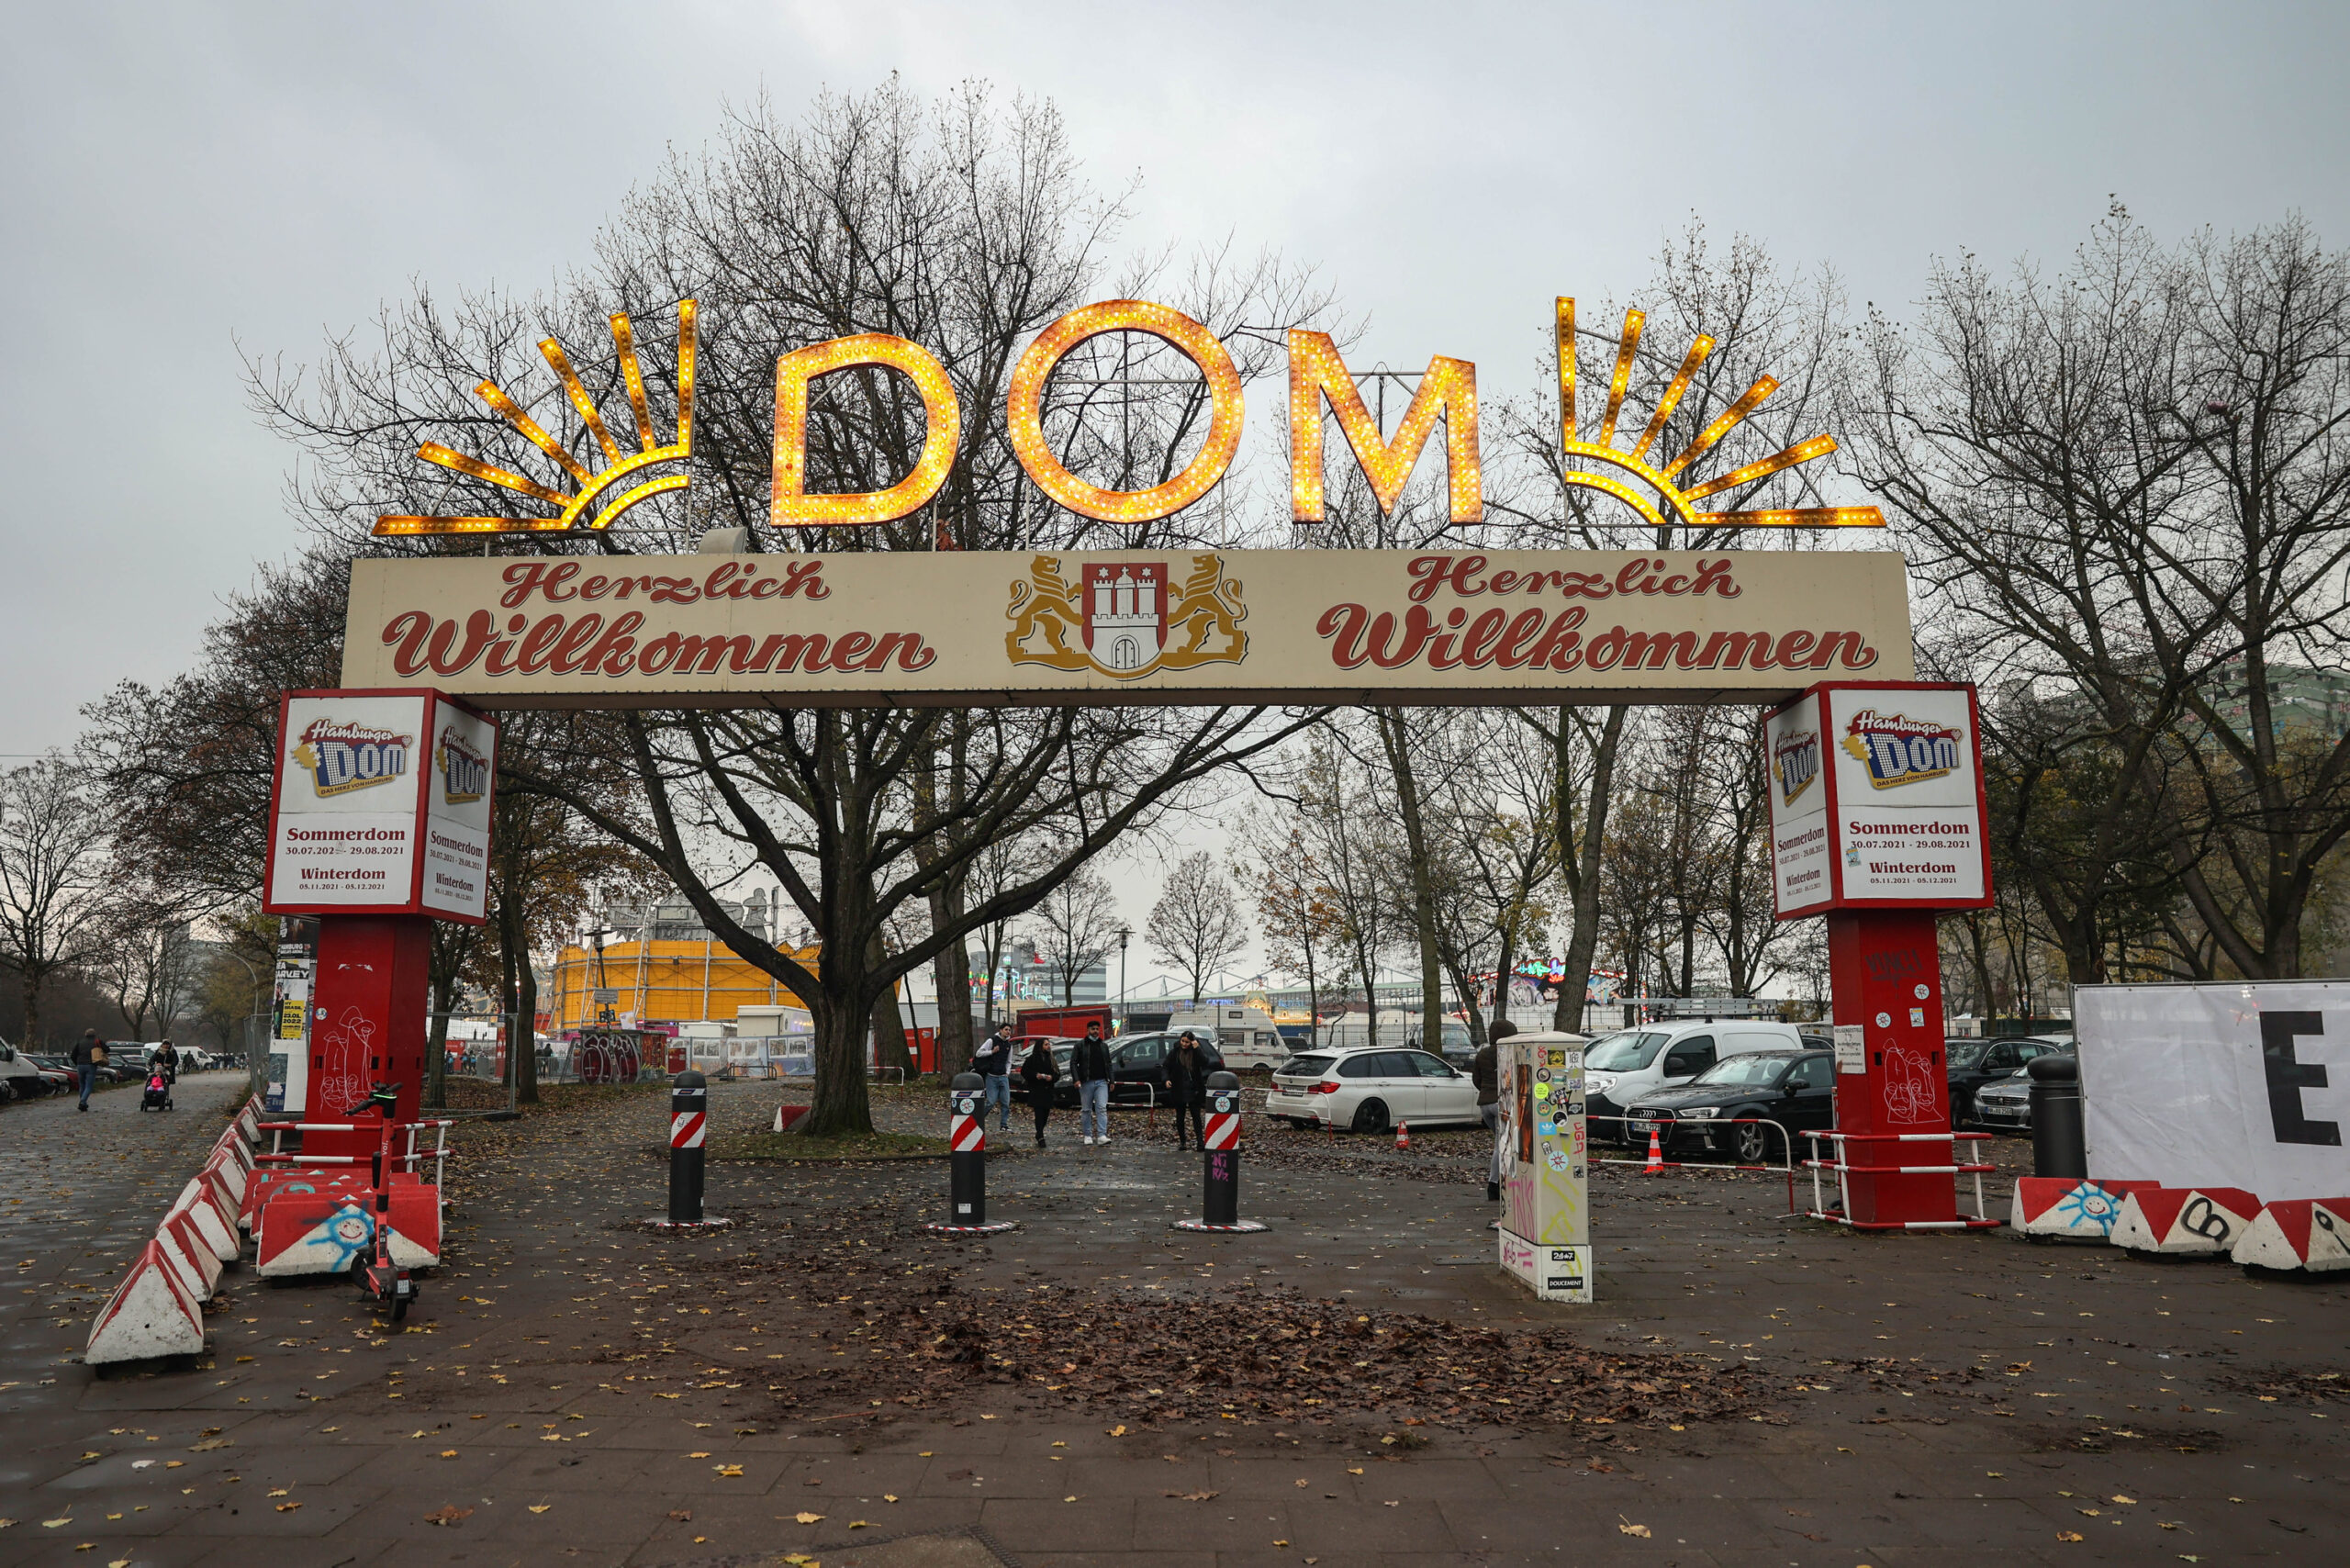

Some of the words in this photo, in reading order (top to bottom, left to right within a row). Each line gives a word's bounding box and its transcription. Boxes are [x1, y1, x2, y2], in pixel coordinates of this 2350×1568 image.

[770, 299, 1482, 525] DOM
[500, 560, 832, 609] Herzlich
[1406, 555, 1743, 603] Herzlich
[380, 610, 937, 678] Willkommen
[1315, 603, 1879, 672] Willkommen
[311, 720, 394, 744] Hamburger
[1857, 711, 1942, 735] Hamburger
[1920, 769, 1948, 778] HAMBURG
[334, 784, 351, 792] HERZ
[365, 777, 393, 786] HAMBURG
[287, 827, 405, 841] Sommerdom
[1850, 821, 1970, 834] Sommerdom
[431, 830, 483, 857] Sommerdom
[1778, 827, 1825, 852] Sommerdom
[1851, 840, 1905, 848] 30.07.2021
[1916, 840, 1970, 848] 29.08.2021
[285, 846, 338, 855] 30.07.202
[350, 846, 404, 855] 29.08.2021
[301, 868, 386, 879] Winterdom
[1869, 861, 1956, 873] Winterdom
[436, 872, 474, 891] Winterdom
[1786, 869, 1820, 887] Winterdom
[2259, 1011, 2342, 1146] E
